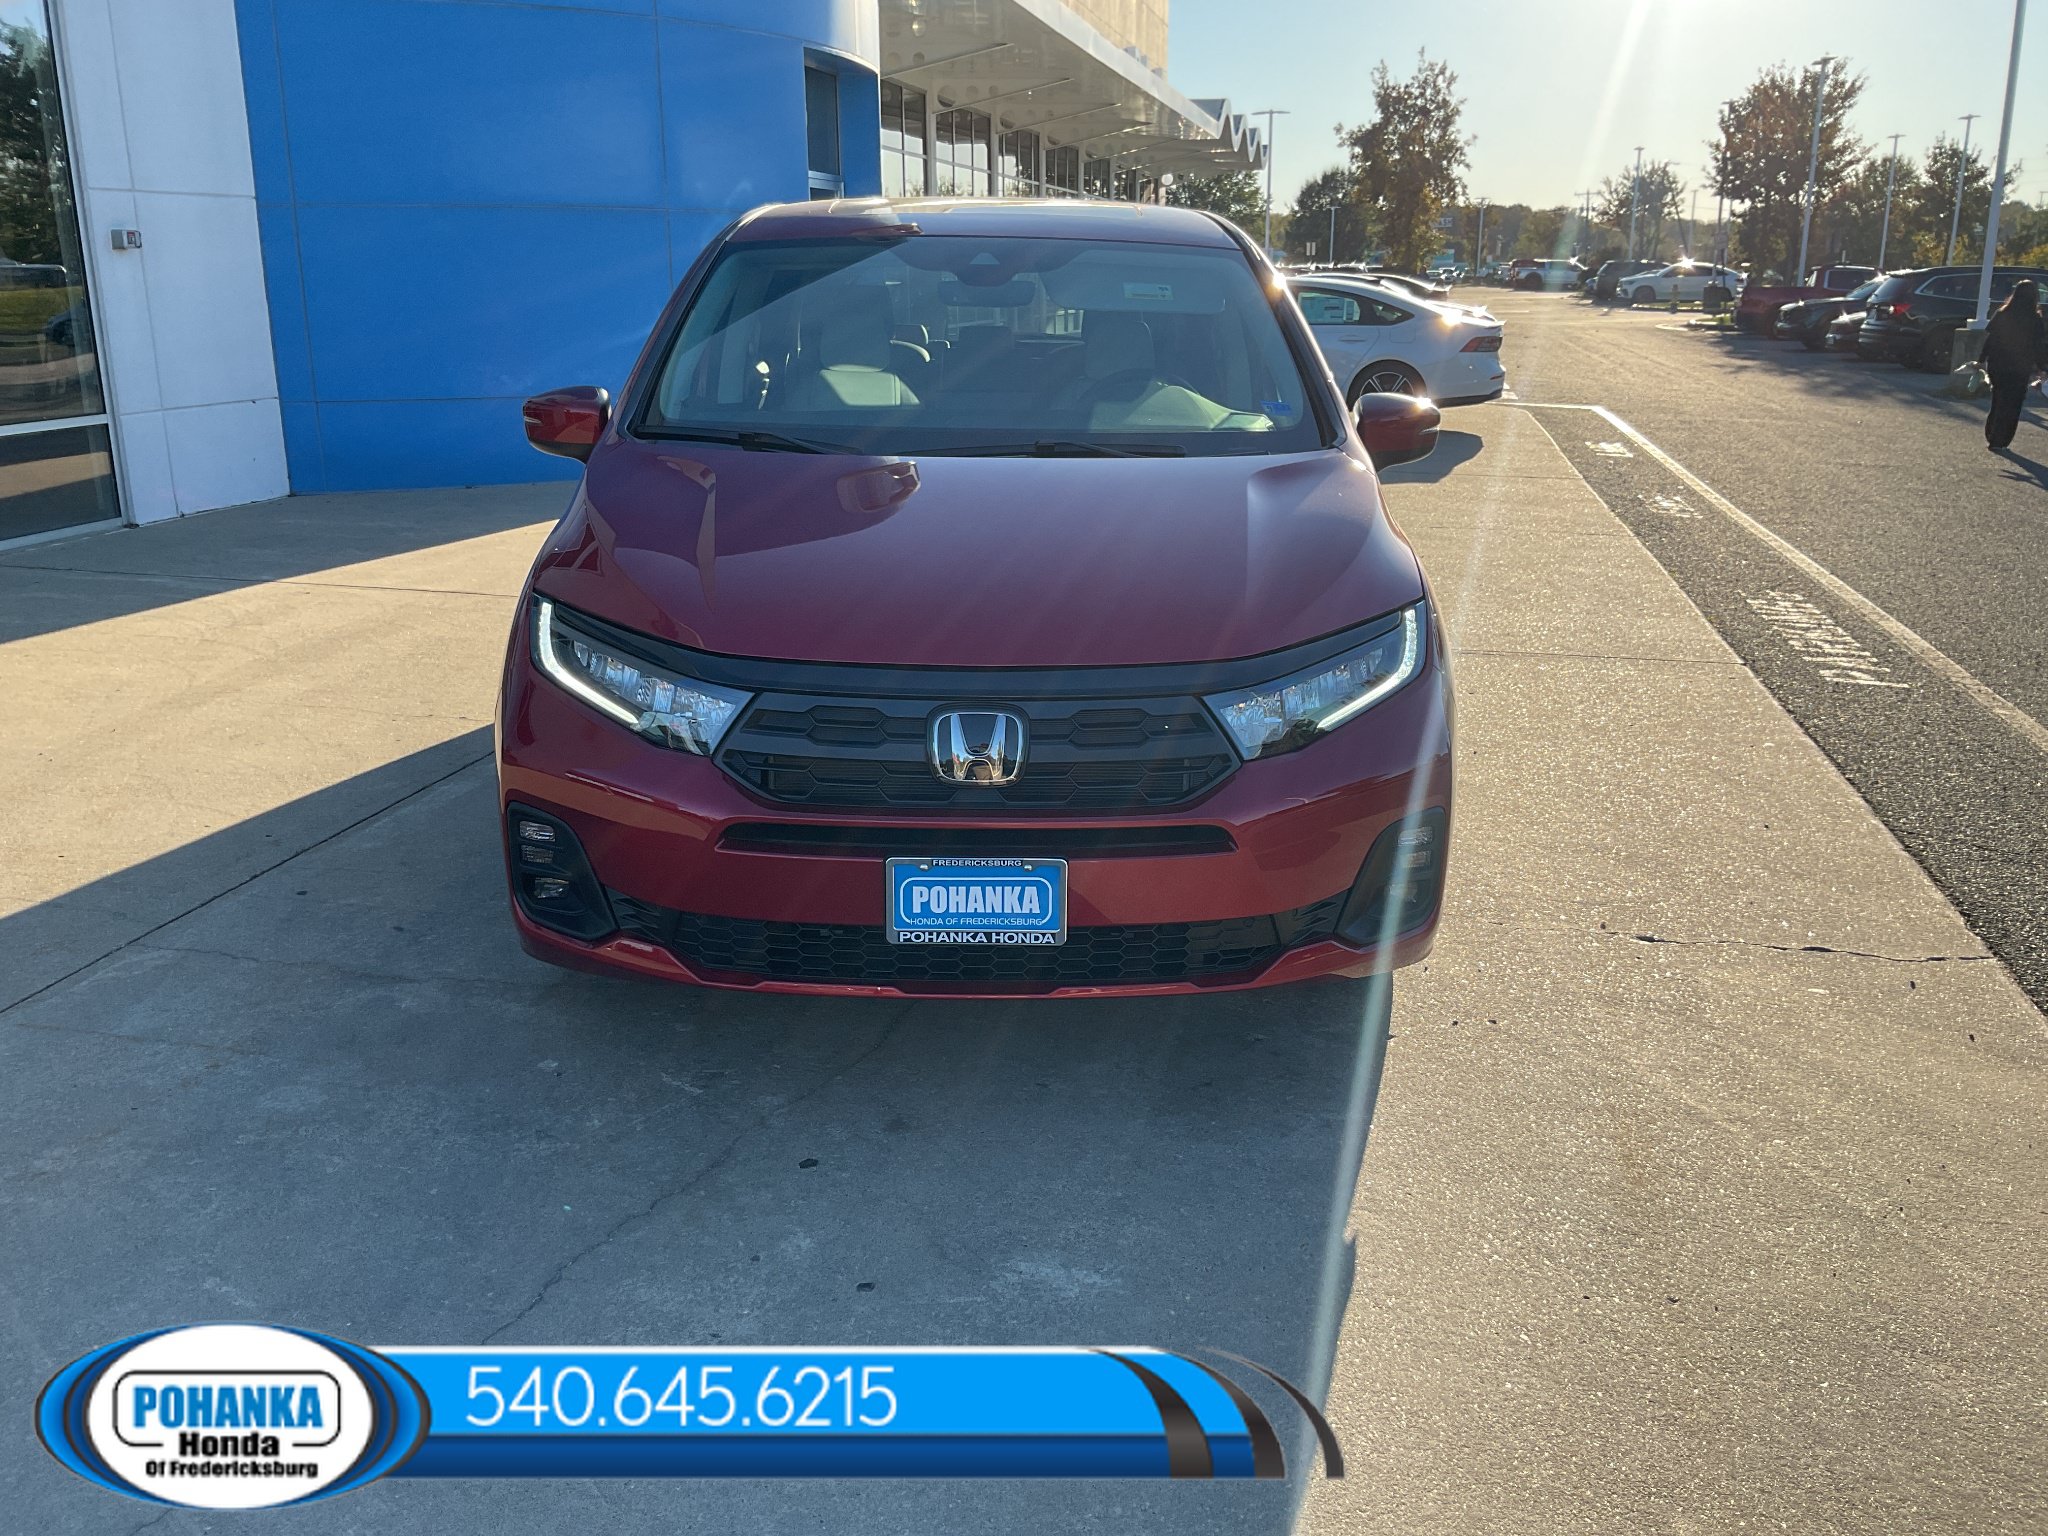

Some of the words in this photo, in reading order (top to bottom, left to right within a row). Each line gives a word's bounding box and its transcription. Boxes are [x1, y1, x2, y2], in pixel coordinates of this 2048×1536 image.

[932, 859, 1022, 867] FREDERICKSBURG
[912, 886, 1041, 914] POHANKA
[910, 917, 944, 925] HONDA
[945, 917, 959, 925] OF
[960, 917, 1043, 926] FREDERICKSBURG
[899, 931, 986, 943] POHANKA
[991, 932, 1055, 944] HONDA
